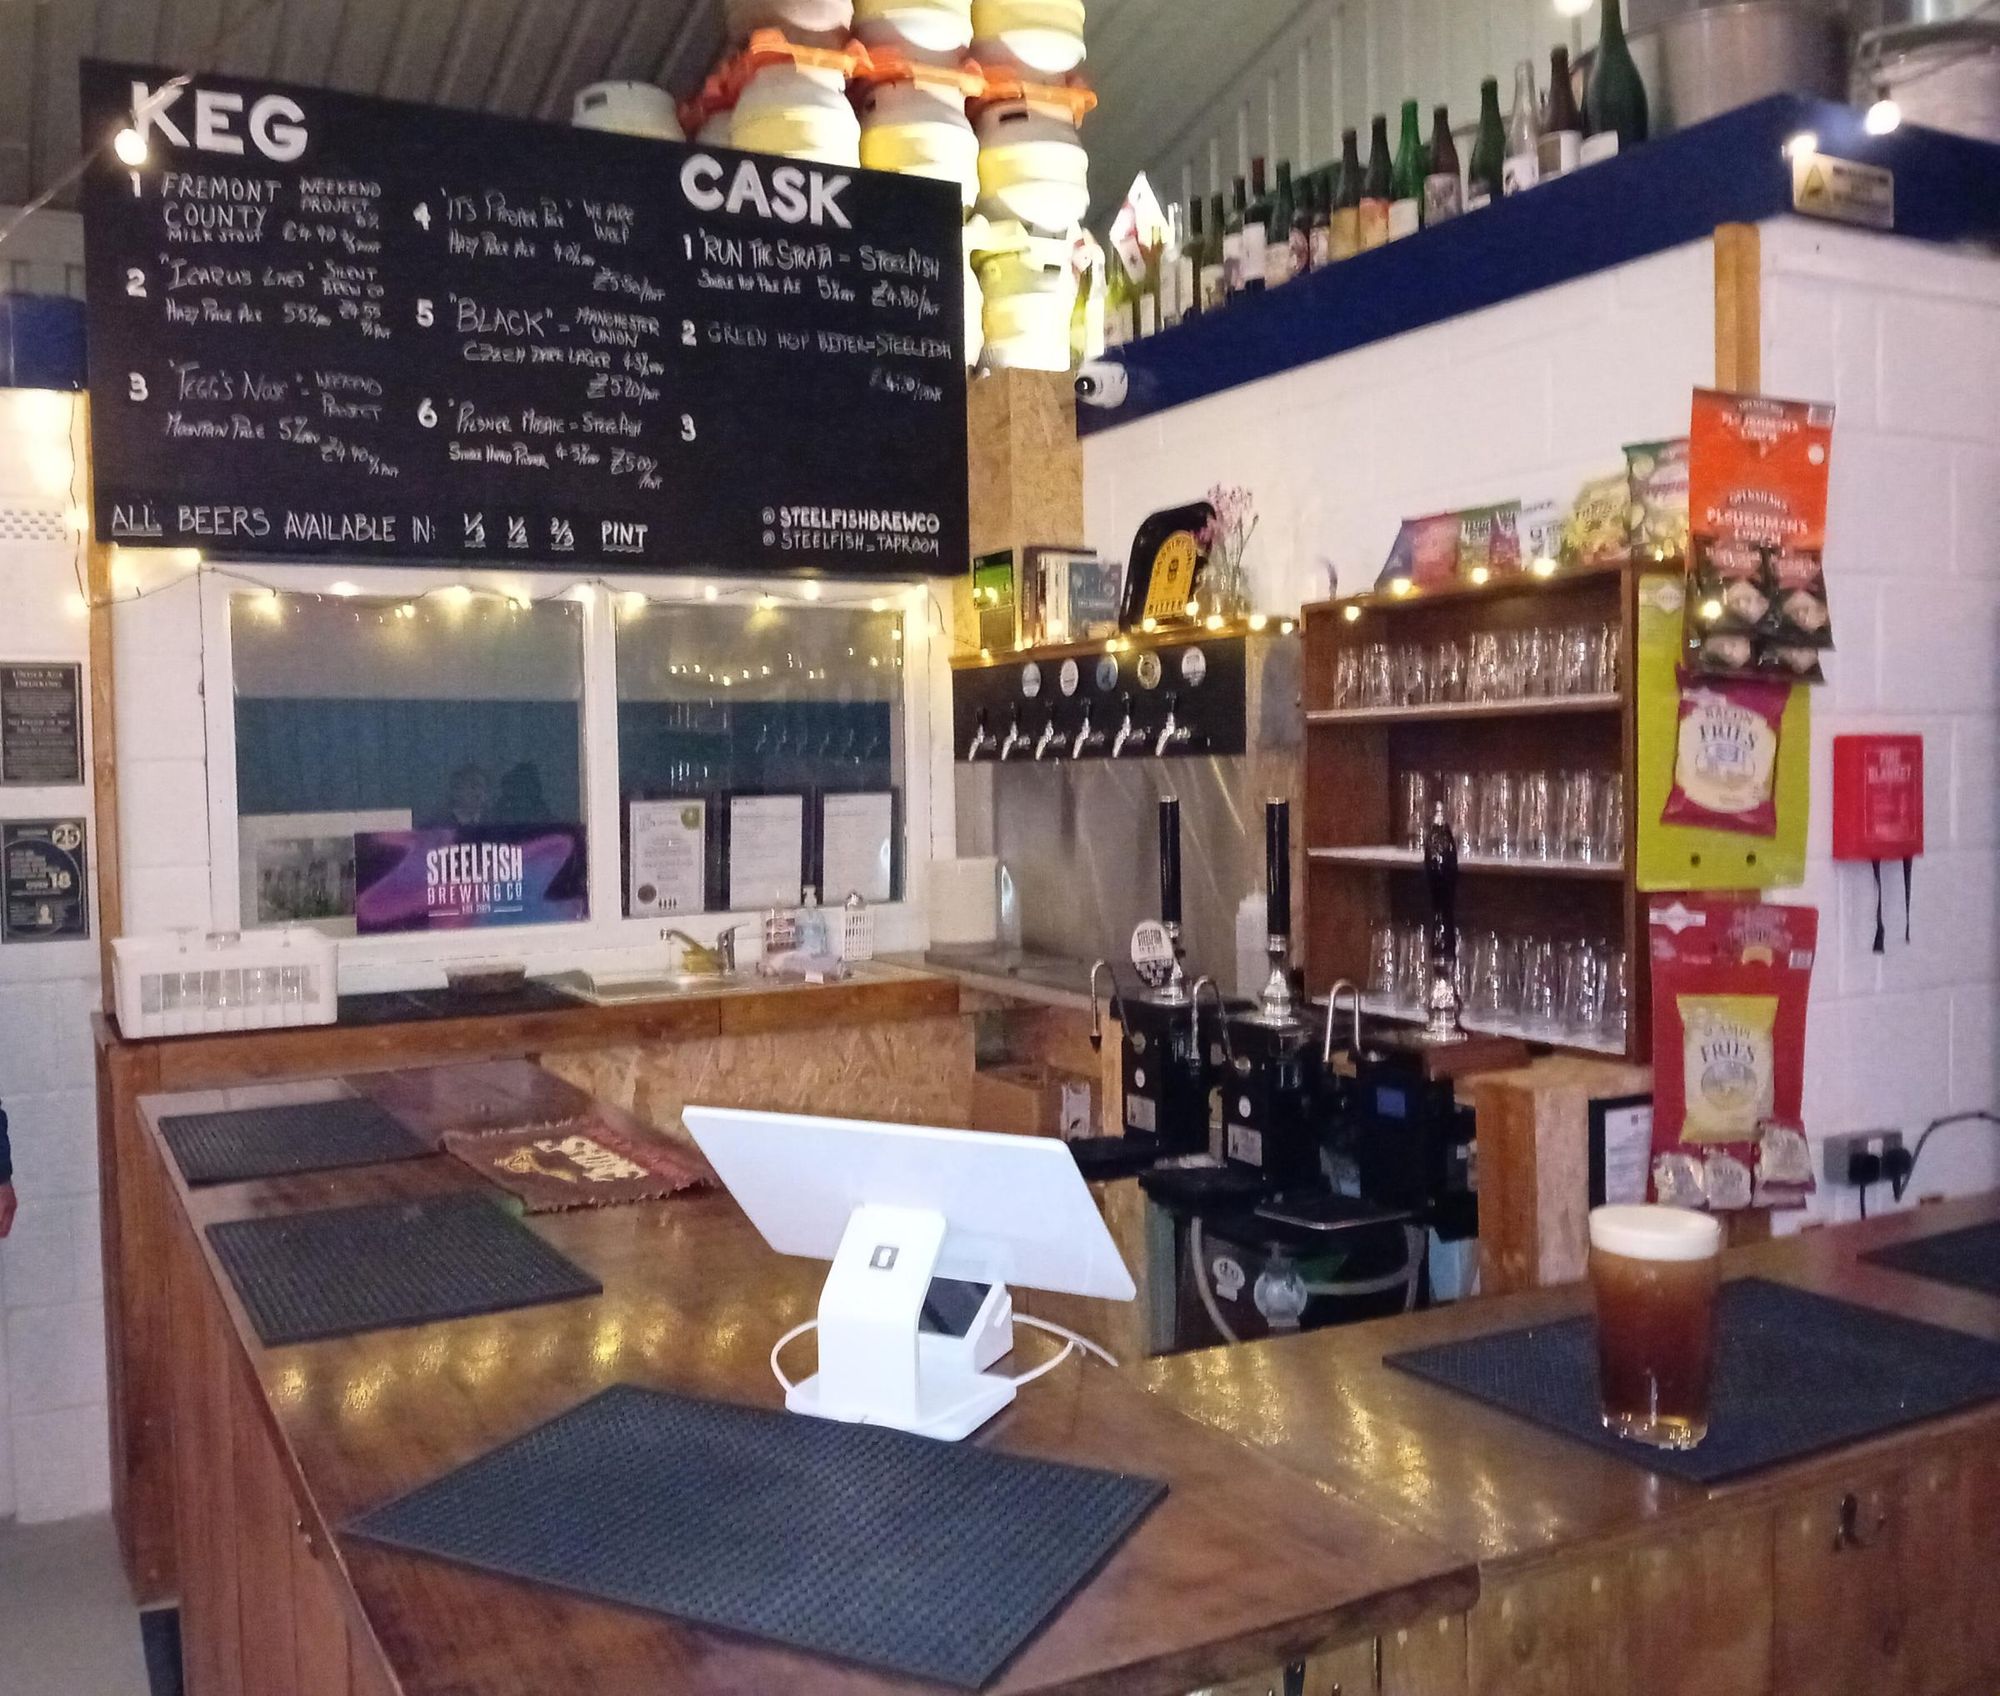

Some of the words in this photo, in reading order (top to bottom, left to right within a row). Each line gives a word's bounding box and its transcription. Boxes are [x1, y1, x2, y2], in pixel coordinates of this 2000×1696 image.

[131, 79, 308, 162] KEG
[161, 171, 282, 203] FREMONT
[679, 153, 853, 229] CASK
[163, 201, 267, 233] COUNTY
[413, 202, 431, 230] 4
[683, 233, 692, 261] 1
[126, 267, 147, 298] 2
[416, 298, 434, 327] 5
[681, 319, 697, 346] 2
[129, 371, 148, 401] 3
[417, 397, 438, 429] 6
[681, 413, 697, 442] 3
[111, 503, 162, 534] ALL
[178, 505, 271, 538] BEERS
[284, 510, 396, 542] AVAILABLE
[601, 519, 648, 549] PINT
[426, 842, 523, 888] STEELFISH
[427, 882, 501, 906] BREWING
[506, 881, 523, 901] CO
